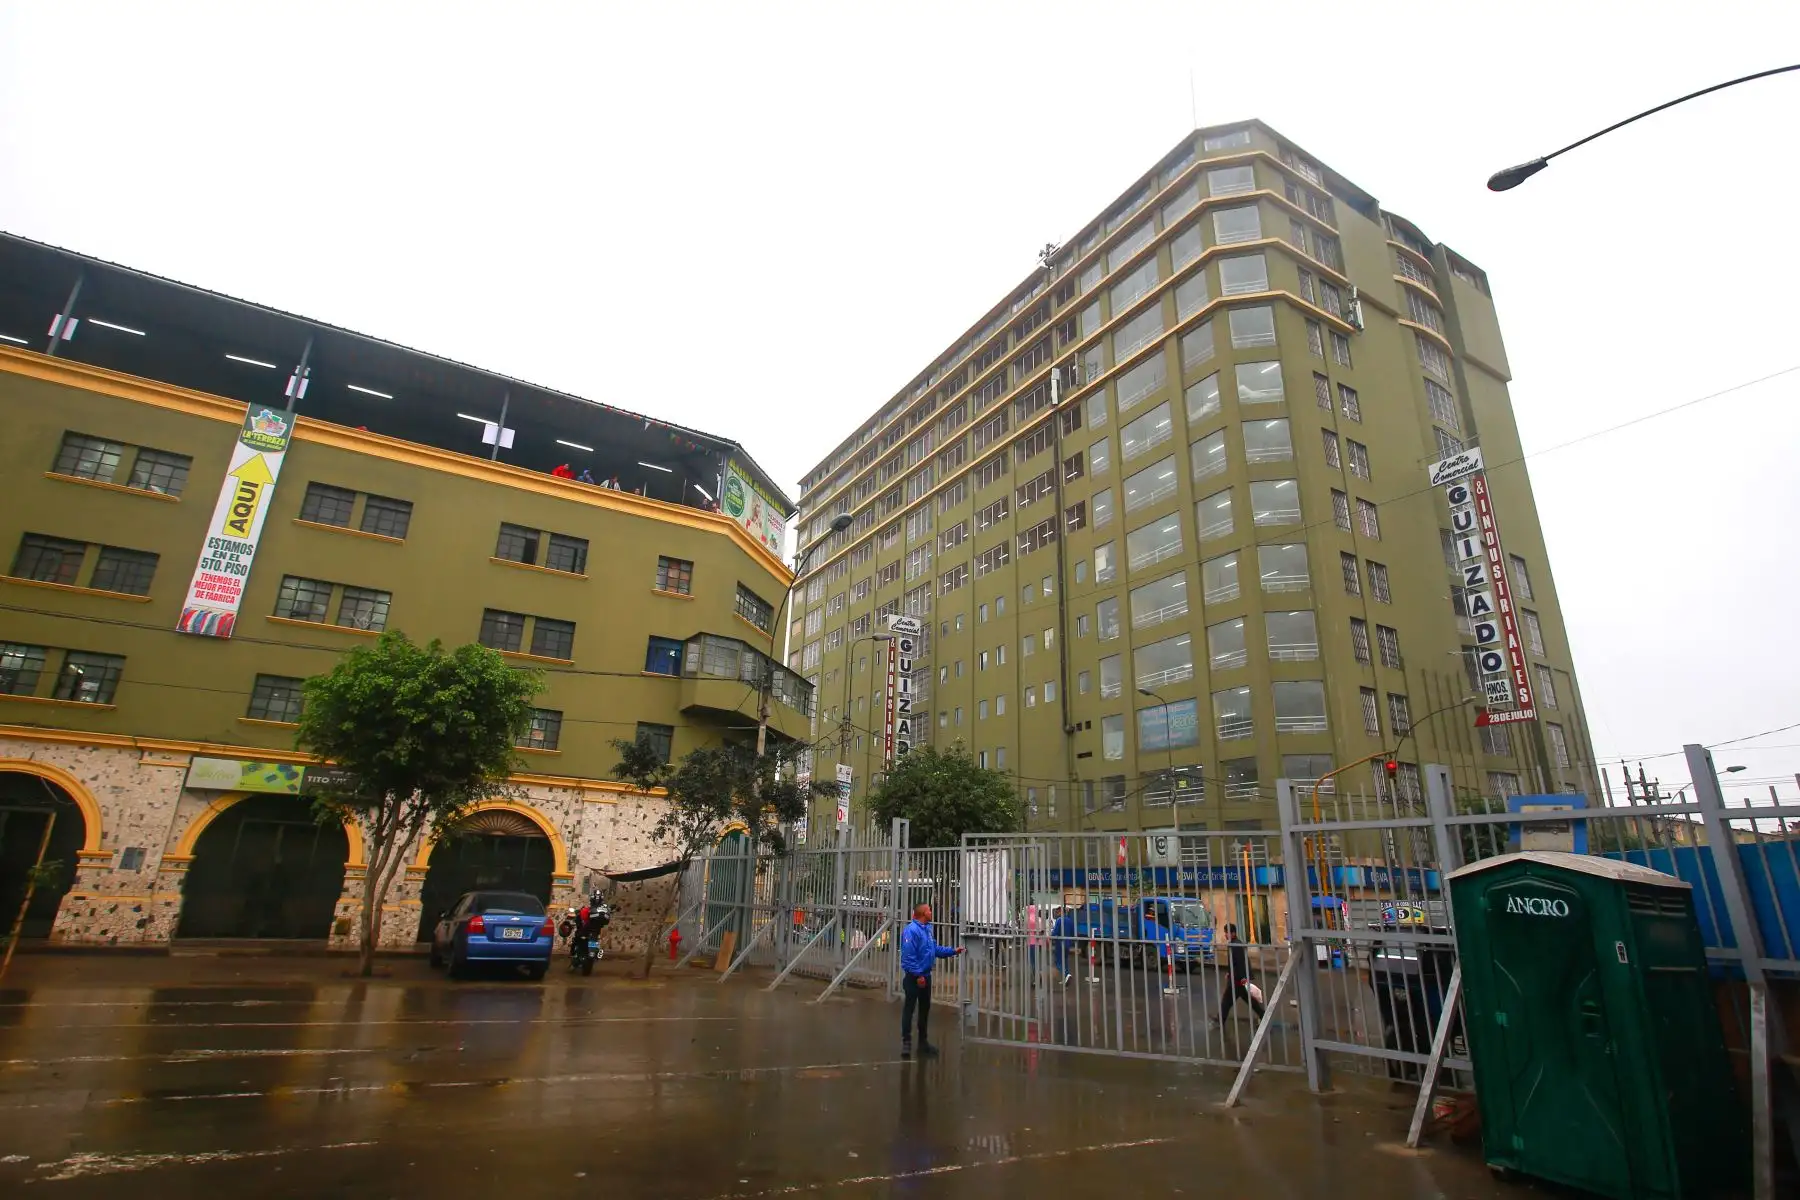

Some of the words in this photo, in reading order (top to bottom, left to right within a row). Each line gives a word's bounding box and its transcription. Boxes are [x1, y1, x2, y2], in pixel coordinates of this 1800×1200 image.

[1432, 458, 1479, 484] Comercial
[1439, 455, 1469, 472] Centro
[229, 480, 259, 533] AQUI
[208, 536, 254, 556] ESTAMOS
[212, 550, 228, 560] EN
[229, 553, 241, 563] EL
[201, 557, 222, 572] 5TO.
[223, 561, 248, 577] PISO
[201, 572, 233, 586] TENEMOS
[233, 578, 241, 588] EL
[1448, 486, 1503, 672] GUIZADO
[194, 580, 218, 592] MEJOR
[217, 584, 242, 596] PRECIO
[194, 589, 206, 599] DE
[205, 591, 236, 604] FABRICA
[1480, 499, 1529, 703] INDUSTRIALES
[1488, 712, 1500, 723] 28
[1500, 711, 1511, 722] DE
[1510, 709, 1533, 720] JULIO
[307, 775, 330, 784] TITO
[1398, 909, 1406, 919] 5
[1506, 895, 1570, 917] ANCRO
